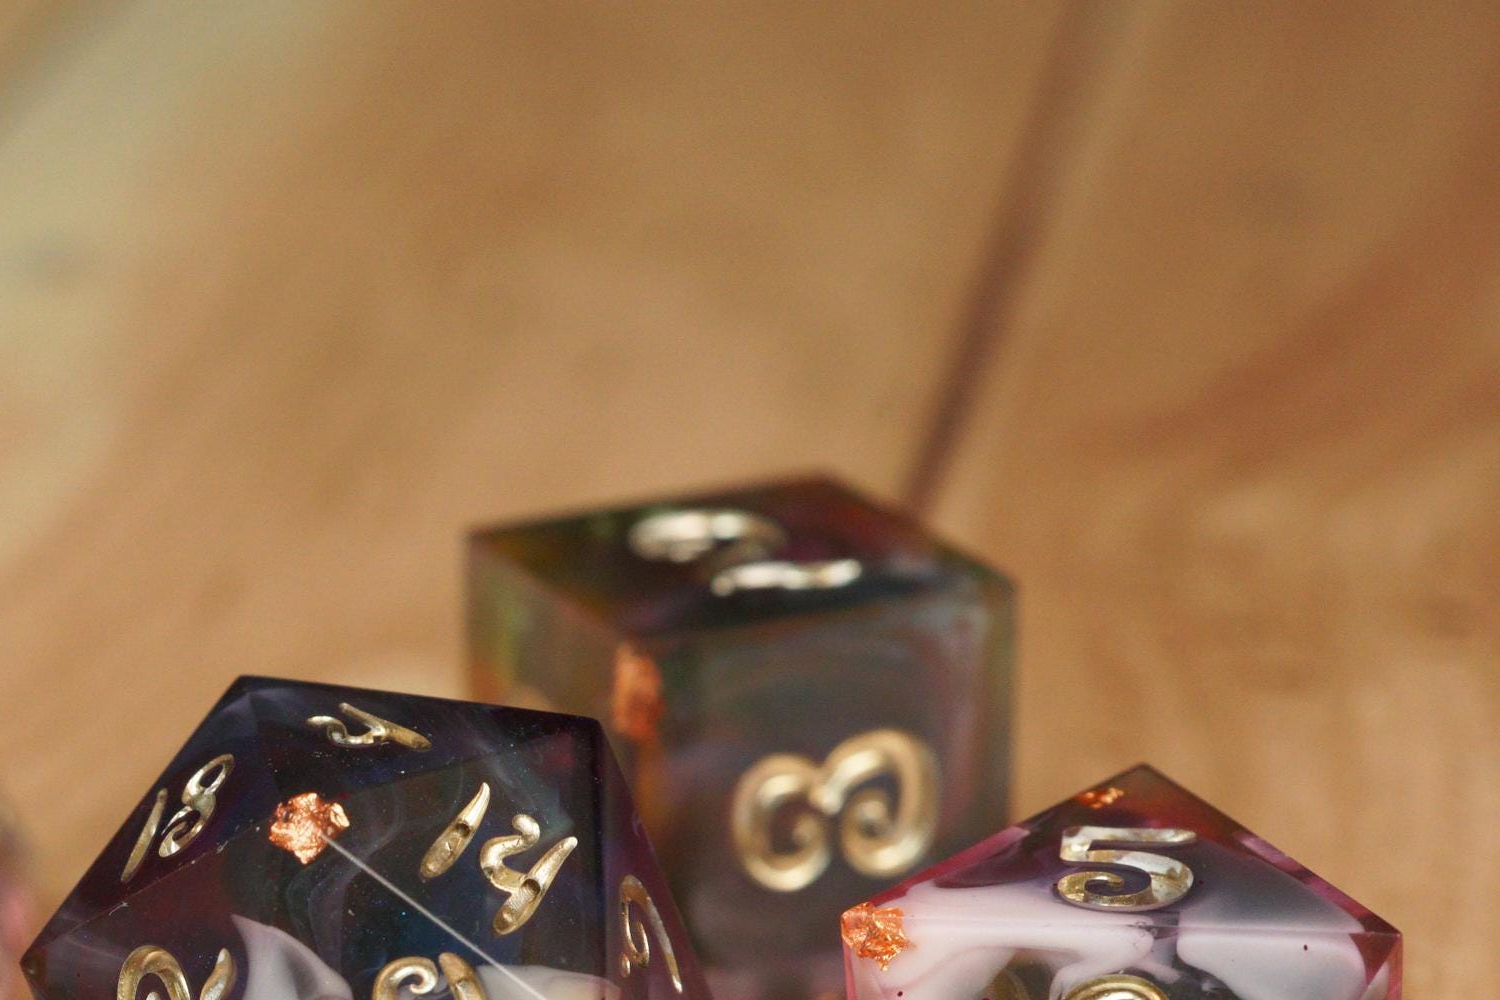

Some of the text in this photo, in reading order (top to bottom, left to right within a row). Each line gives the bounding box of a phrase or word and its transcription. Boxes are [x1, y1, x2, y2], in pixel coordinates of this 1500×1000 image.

[120, 754, 235, 883] 18
[419, 782, 577, 936] 14
[732, 729, 940, 892] 3
[1057, 826, 1197, 912] 5
